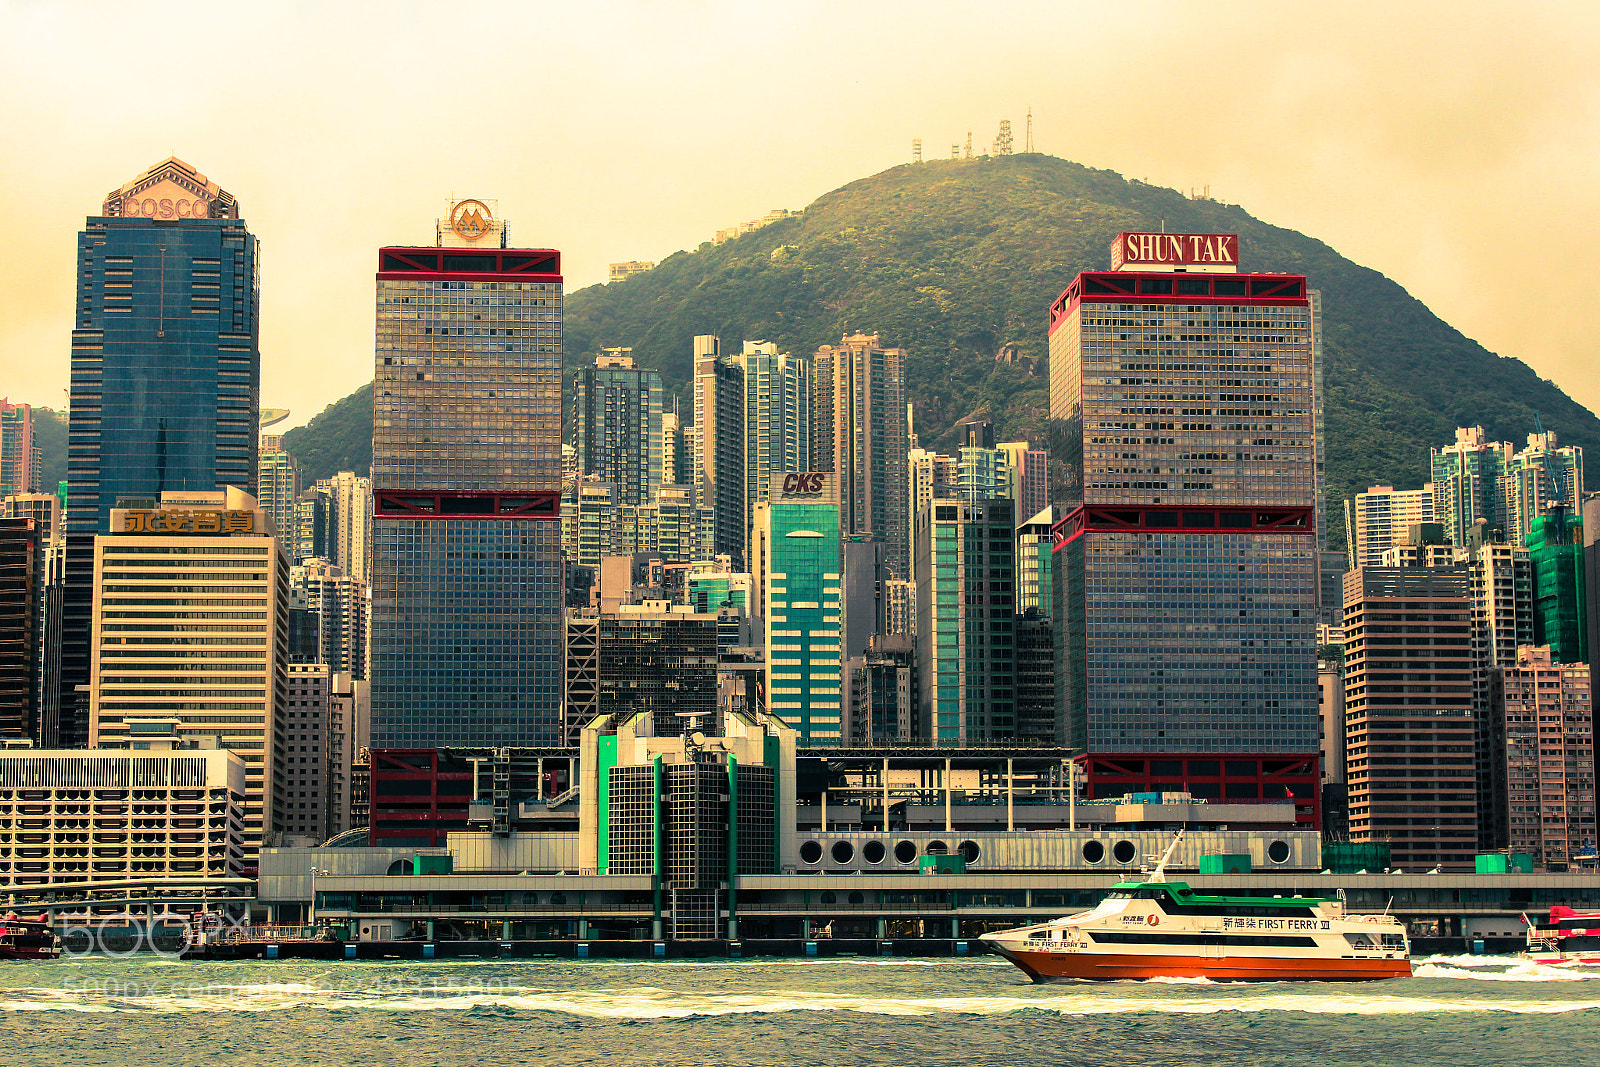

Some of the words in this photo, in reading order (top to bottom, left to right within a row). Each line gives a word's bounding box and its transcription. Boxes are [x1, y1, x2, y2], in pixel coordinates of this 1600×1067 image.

[125, 198, 208, 218] COSCO
[1127, 234, 1184, 261] SHUN
[1189, 236, 1233, 262] TAK
[783, 473, 825, 492] CKS
[124, 509, 253, 532] 永安百貨
[1258, 920, 1285, 929] FIRST
[1288, 920, 1317, 929] FERRY
